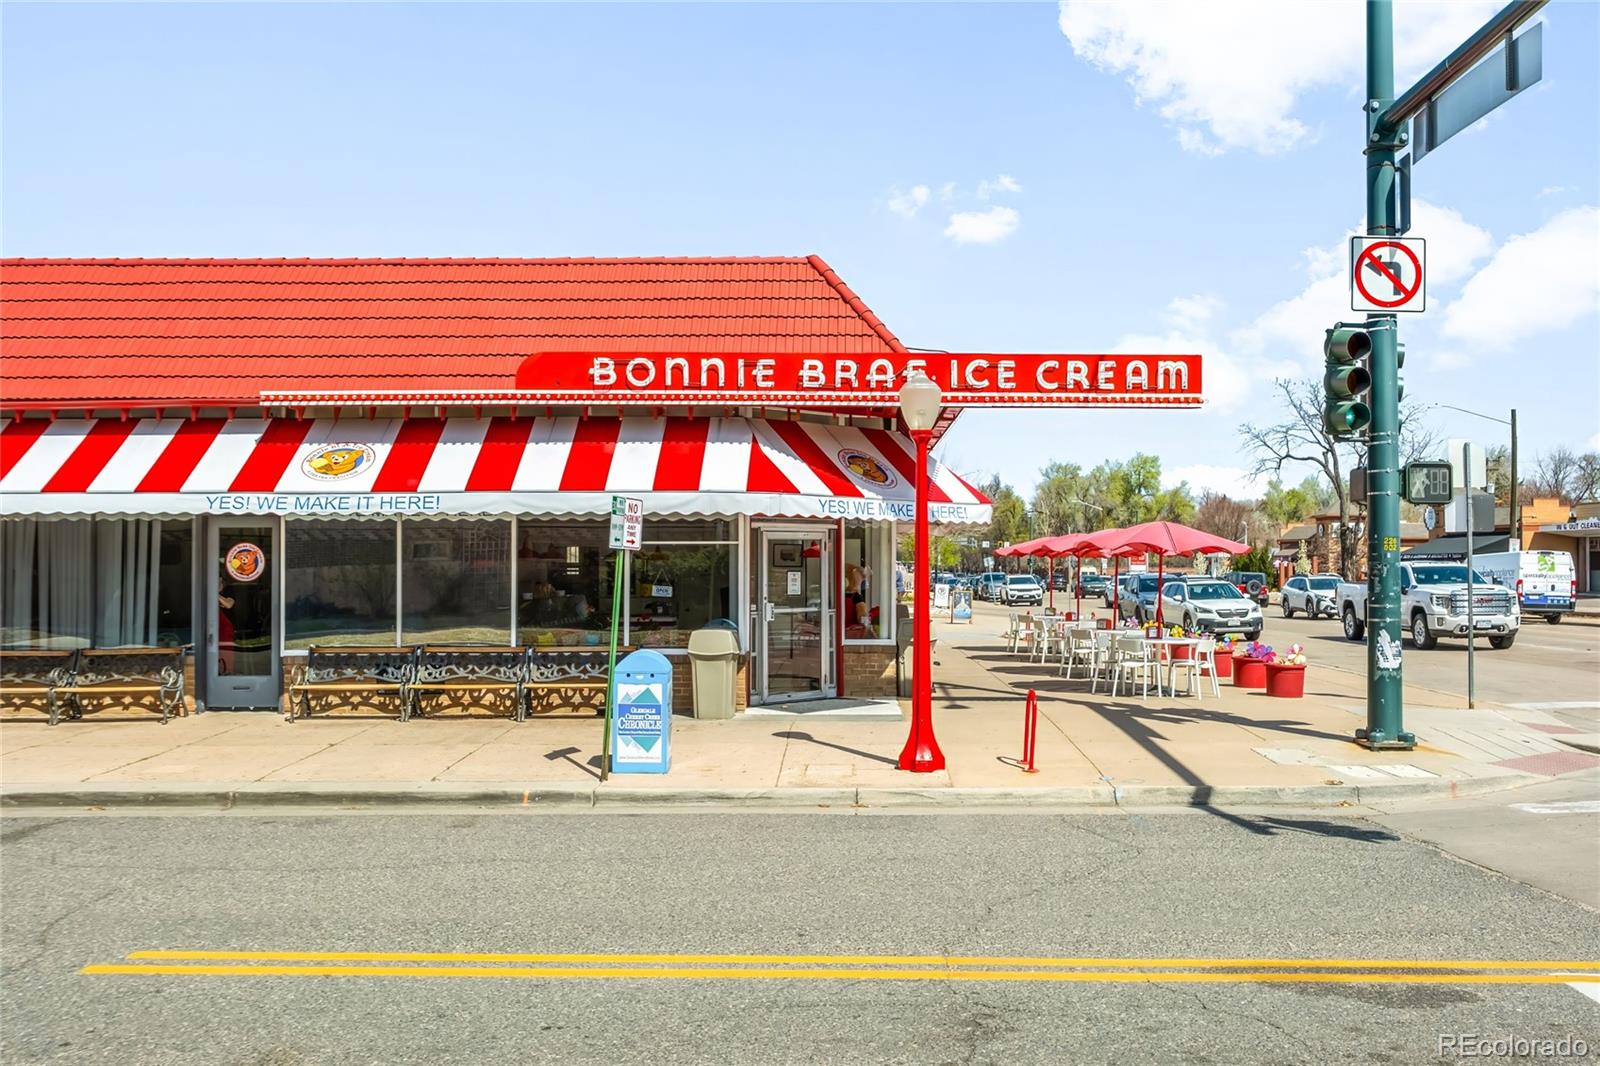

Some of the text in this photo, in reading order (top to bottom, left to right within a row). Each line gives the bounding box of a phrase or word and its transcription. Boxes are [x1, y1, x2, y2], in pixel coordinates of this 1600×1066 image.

[588, 357, 776, 388] BONNIE
[951, 359, 1017, 389] ICE
[1036, 360, 1189, 390] CREAM
[206, 495, 441, 510] YES! WE MAKE IT HERE!
[628, 502, 639, 514] NO
[818, 499, 969, 520] YES! WE MAKE HERE!
[1569, 522, 1579, 530] OUT
